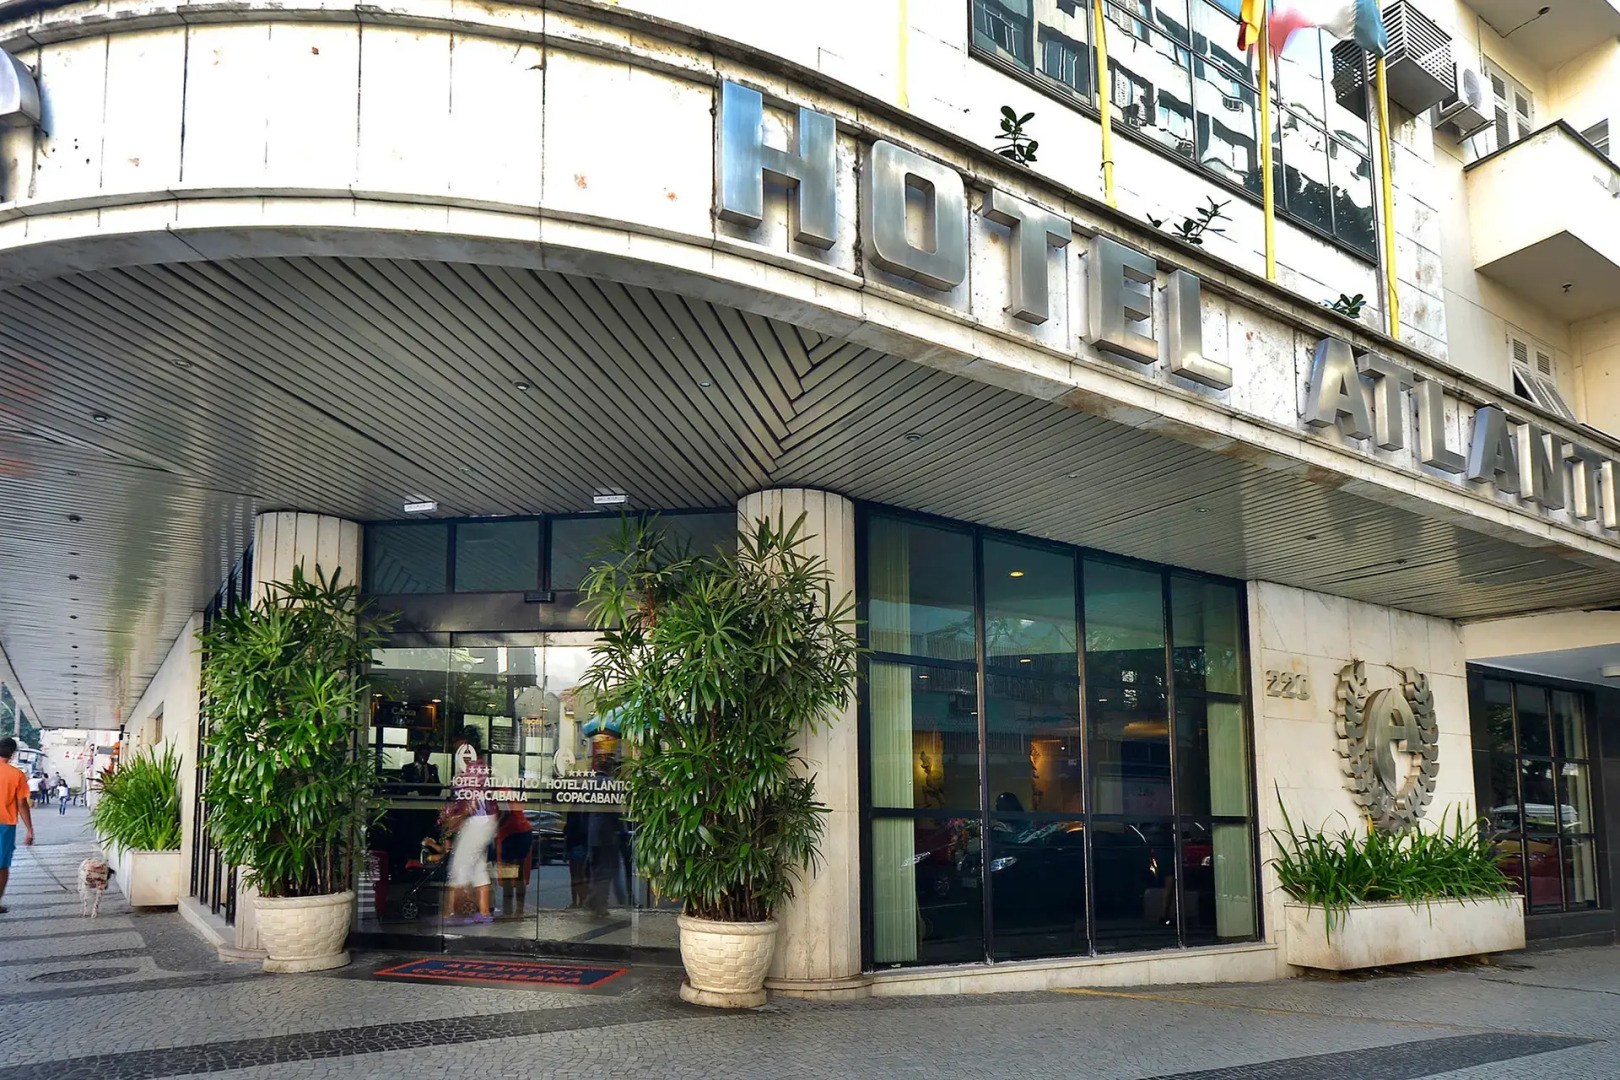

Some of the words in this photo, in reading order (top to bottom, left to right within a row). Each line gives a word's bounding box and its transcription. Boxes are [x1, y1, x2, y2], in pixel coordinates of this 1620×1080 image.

[717, 80, 1232, 390] HOTEL
[546, 779, 581, 790] HOTEL
[457, 789, 528, 802] COPACABANA
[556, 792, 627, 804] COPACABANA
[412, 967, 582, 983] COPACABANA
